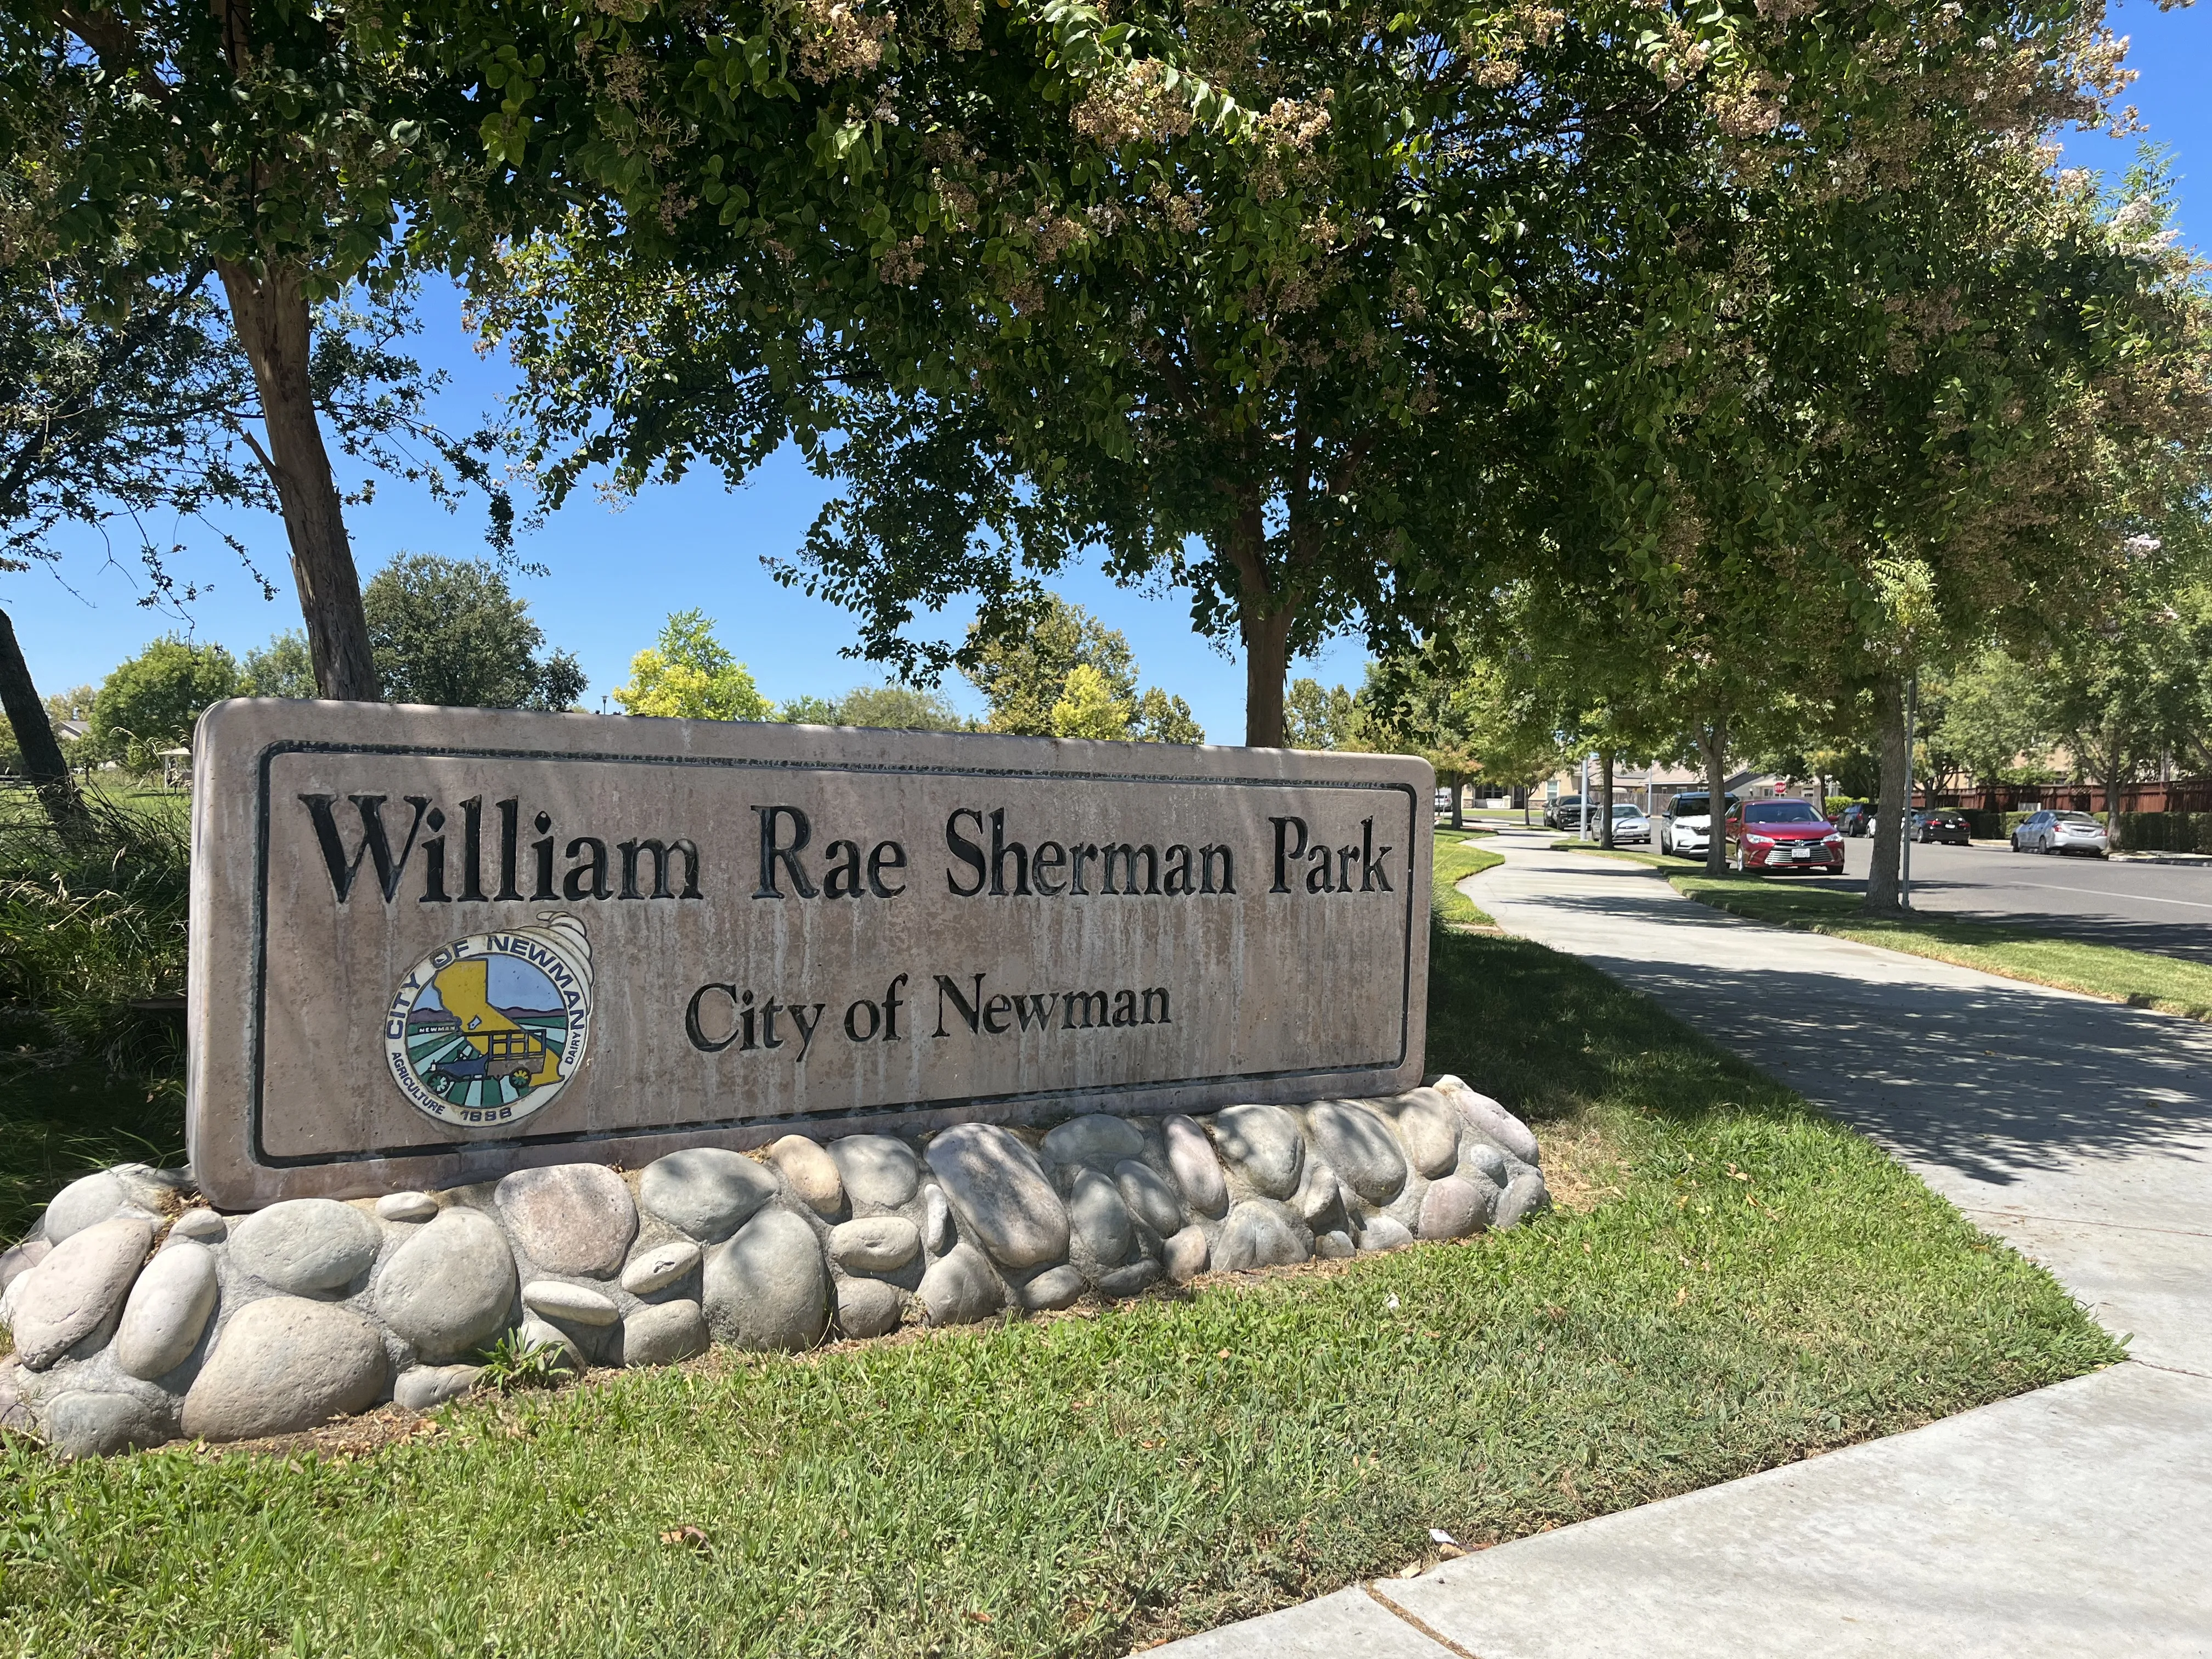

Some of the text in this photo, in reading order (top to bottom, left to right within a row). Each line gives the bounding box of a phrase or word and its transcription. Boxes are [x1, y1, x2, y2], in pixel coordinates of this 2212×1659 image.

[297, 793, 1394, 904] William Rae Sherman Park
[387, 936, 585, 1039] CITY OF NEWMAN
[686, 972, 1172, 1062] City of Newman
[392, 1052, 445, 1115] AGRICULTURE
[565, 1031, 582, 1065] DAIRY
[460, 1107, 512, 1122] 1888
